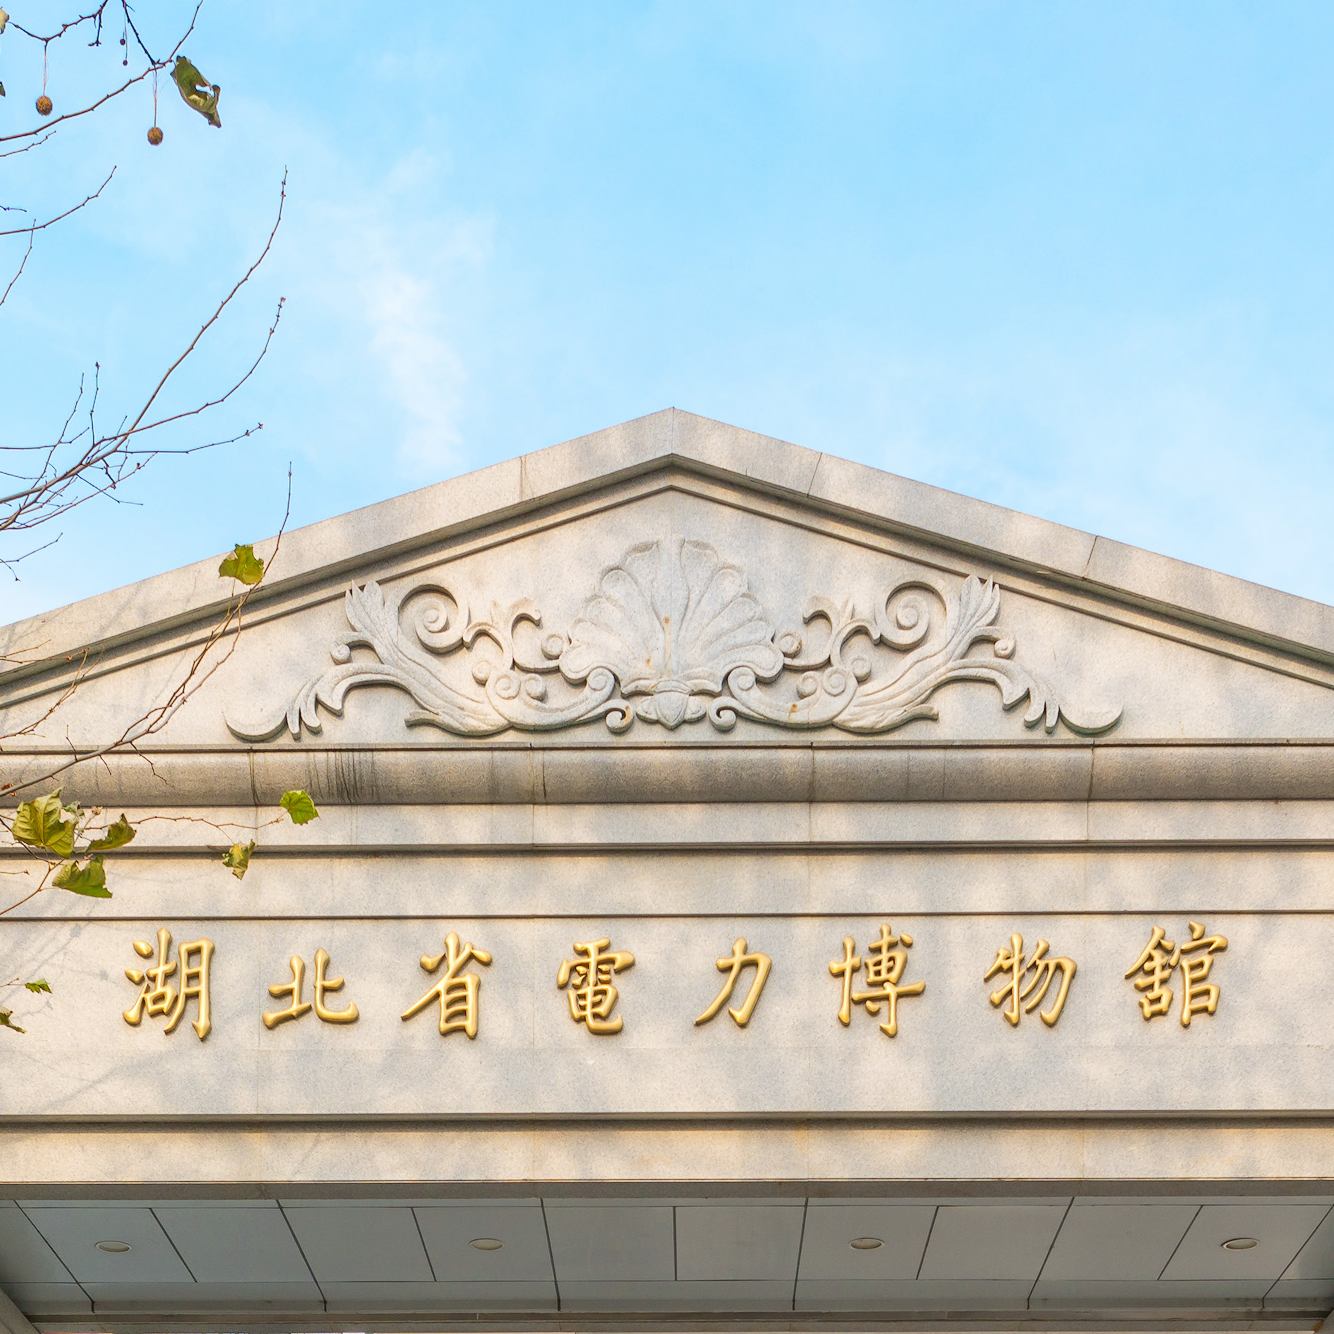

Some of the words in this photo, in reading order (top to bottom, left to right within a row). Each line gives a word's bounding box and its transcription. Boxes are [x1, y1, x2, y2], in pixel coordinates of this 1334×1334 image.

[123, 921, 1228, 1041] 湖北省電力博物舘
